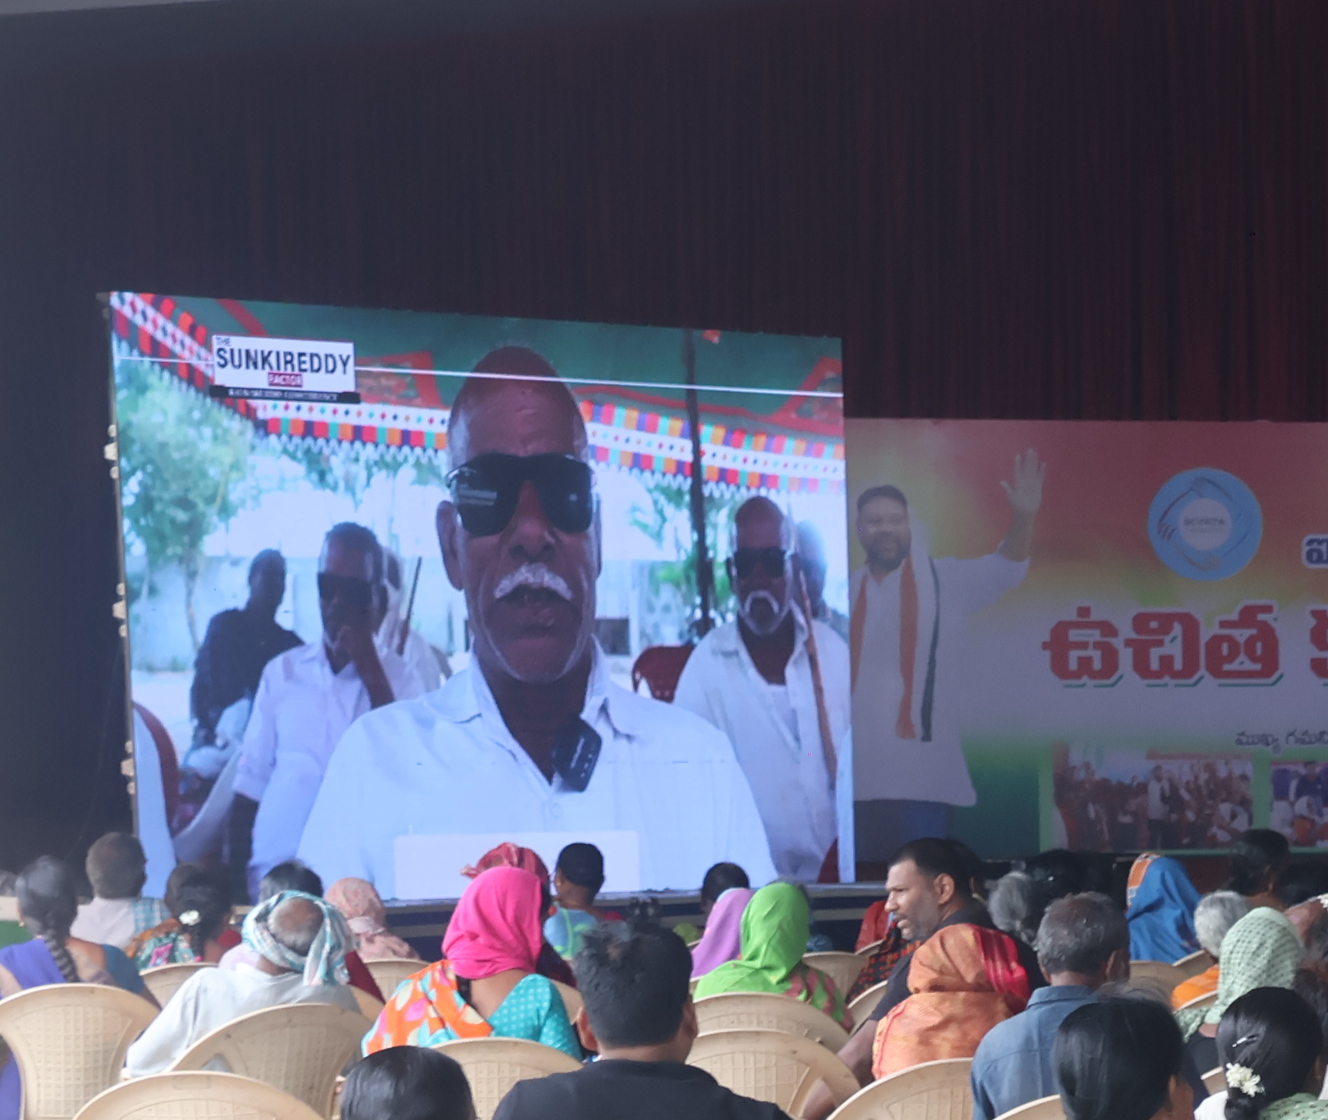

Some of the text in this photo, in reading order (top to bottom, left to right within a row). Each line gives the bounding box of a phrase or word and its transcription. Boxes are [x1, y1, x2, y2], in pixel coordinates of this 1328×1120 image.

[216, 347, 351, 375] SUNKIREDDY
[269, 373, 302, 386] FACTOR
[1041, 603, 1283, 687] ఉచిత
